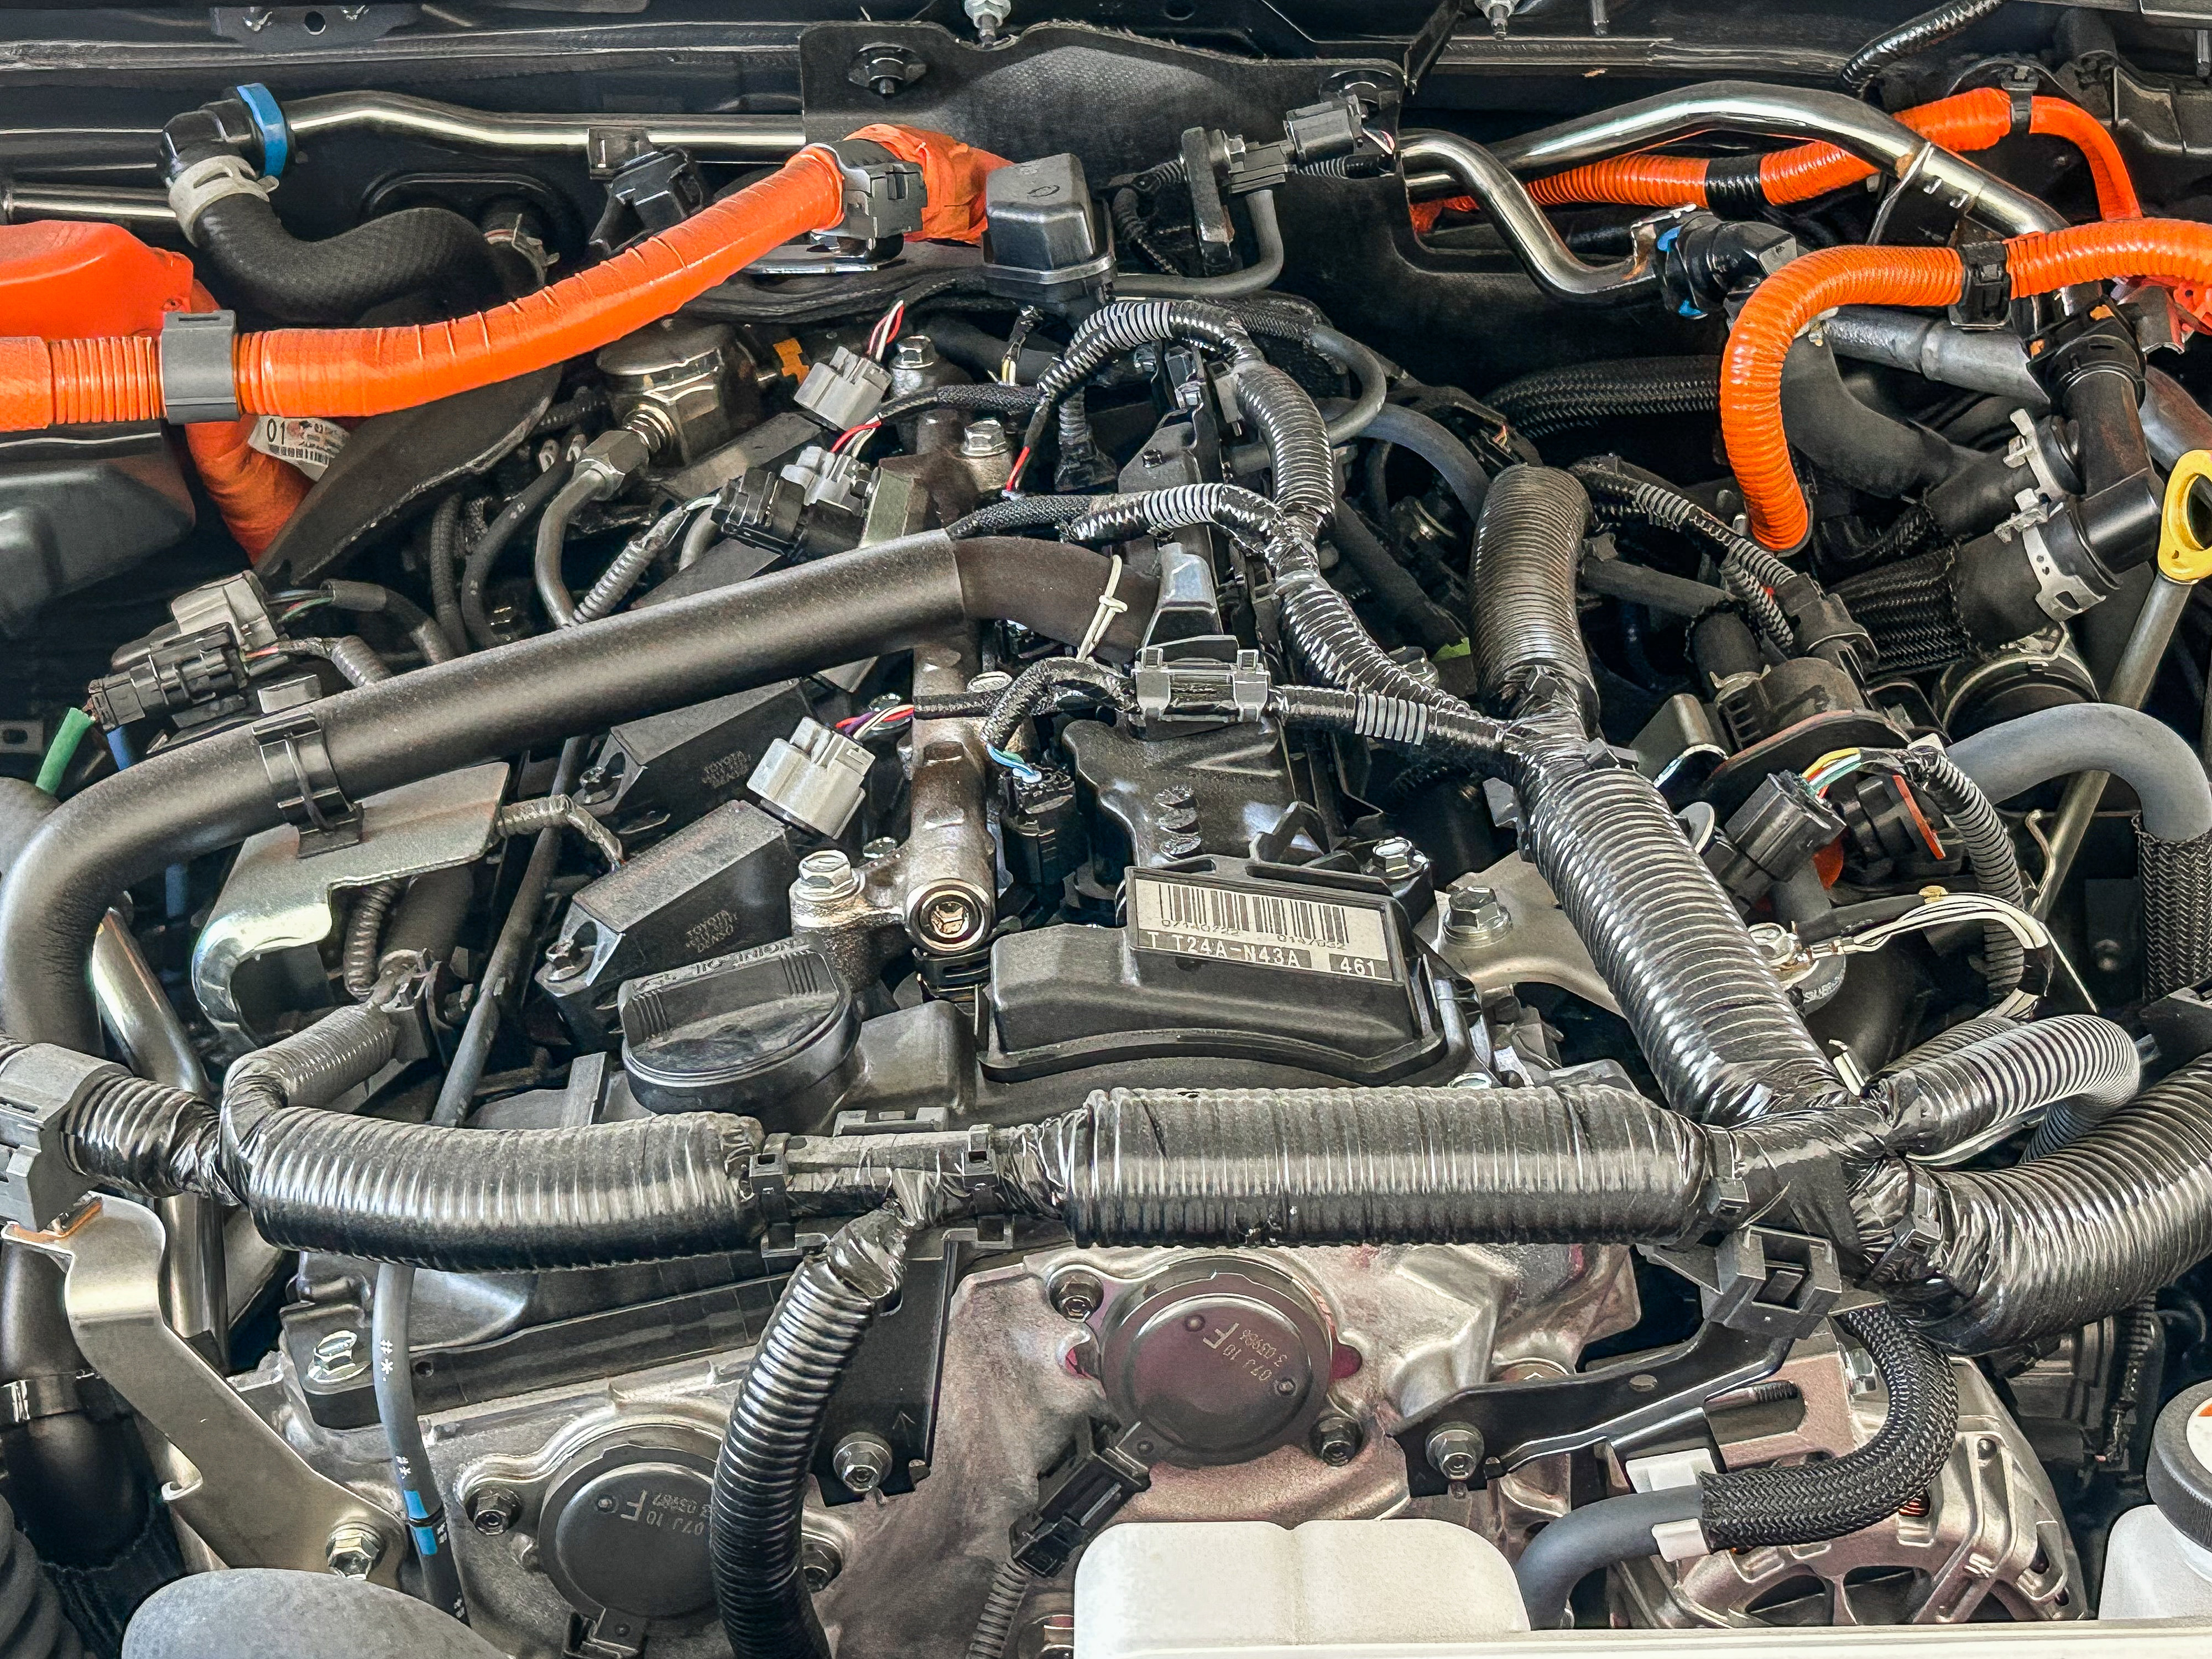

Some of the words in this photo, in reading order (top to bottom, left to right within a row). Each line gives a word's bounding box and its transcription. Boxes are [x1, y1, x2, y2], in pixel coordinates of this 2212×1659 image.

[1146, 931, 1159, 948] T
[1172, 933, 1301, 968] T24A-N43A
[1339, 957, 1375, 978] 461
[1202, 1322, 1240, 1350] F
[620, 1489, 648, 1521] F
